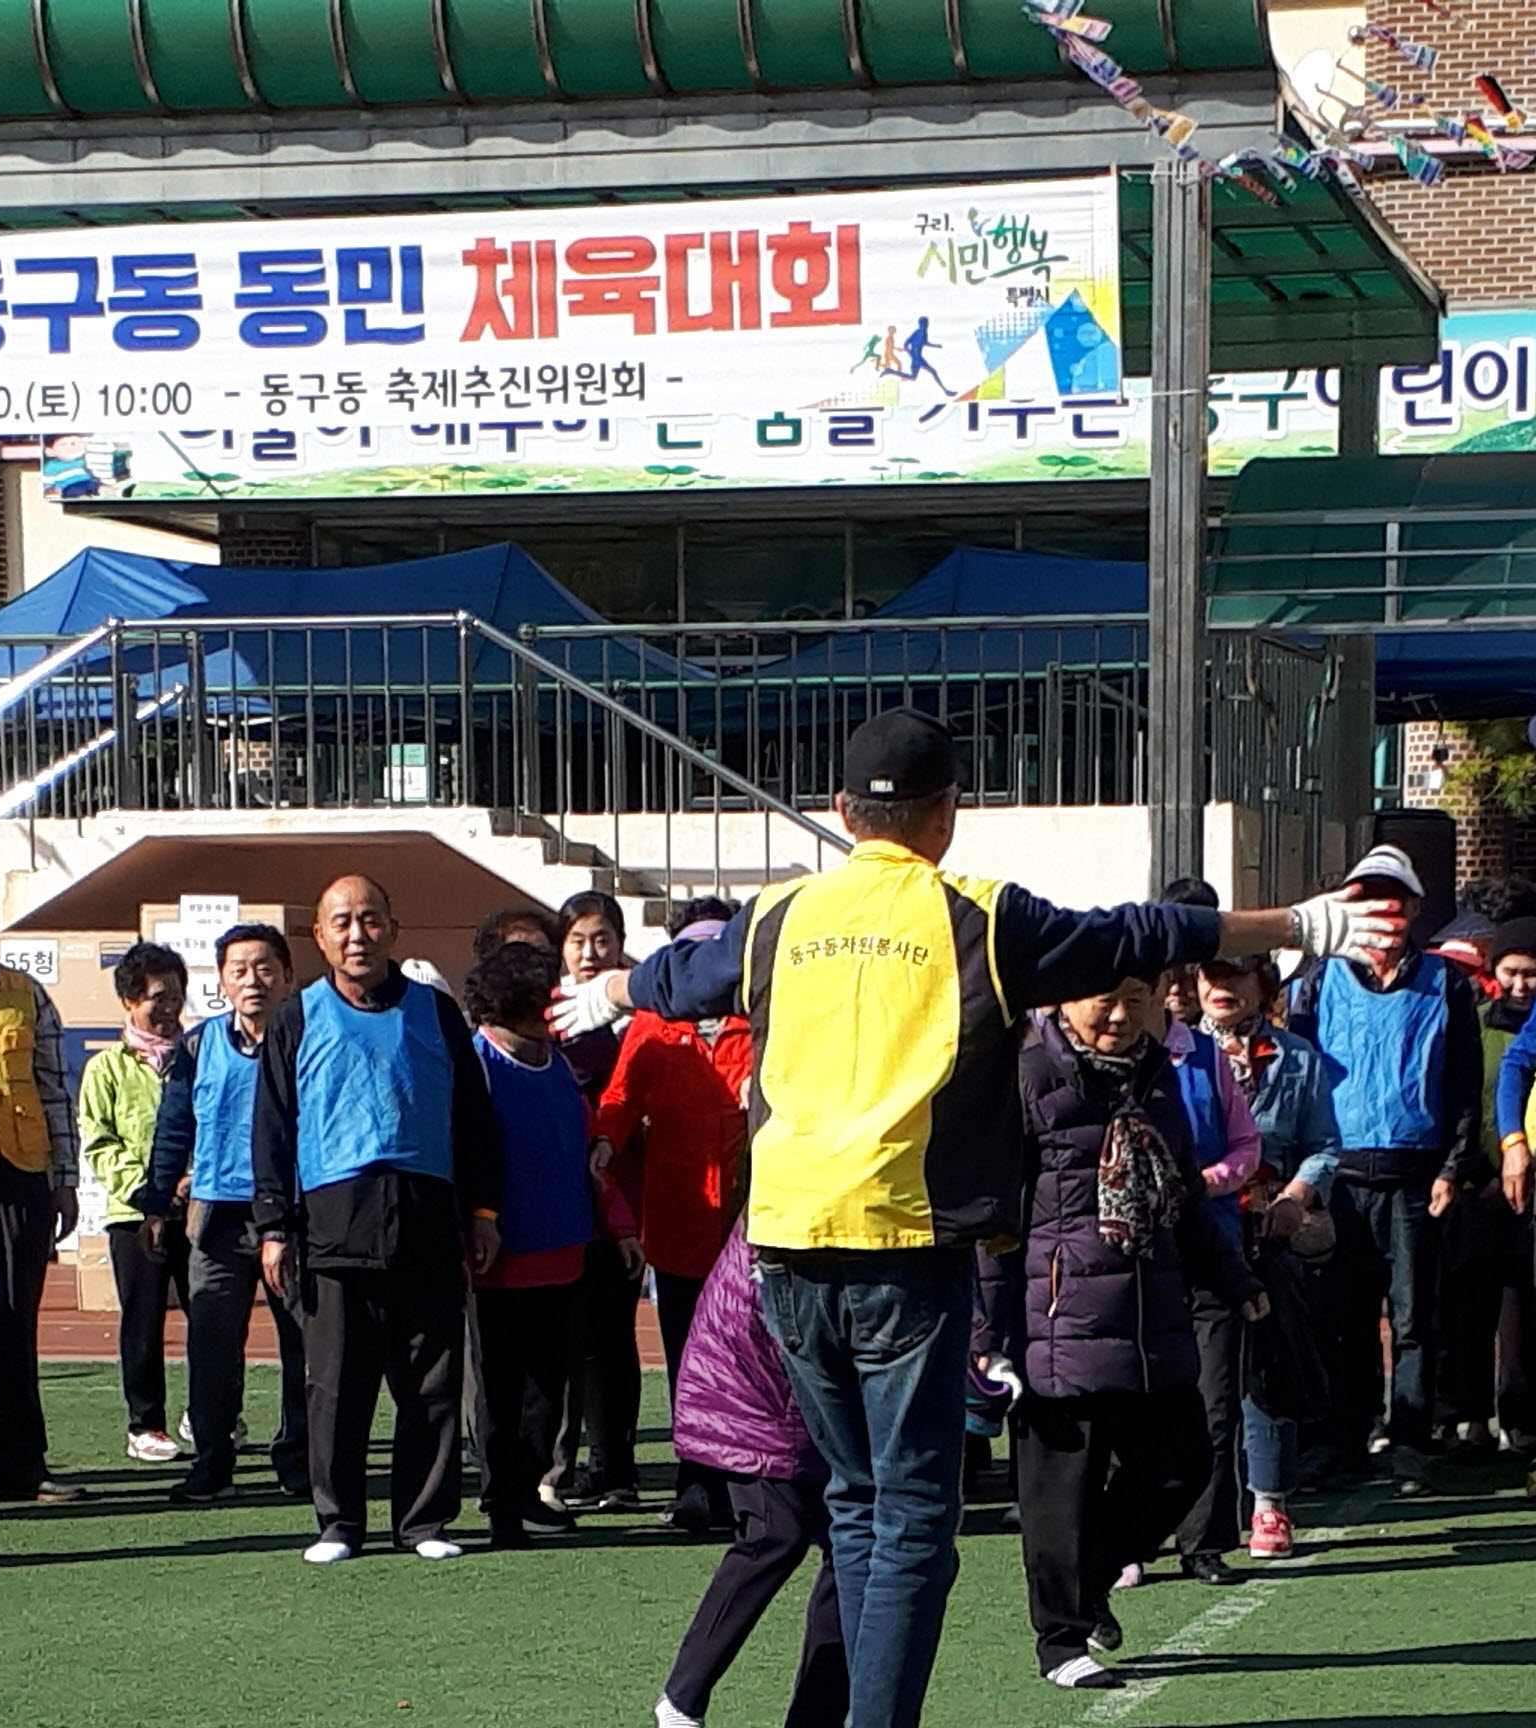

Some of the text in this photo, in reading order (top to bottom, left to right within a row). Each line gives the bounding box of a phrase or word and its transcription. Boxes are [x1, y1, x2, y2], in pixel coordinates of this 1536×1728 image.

[234, 244, 426, 349] 동민
[459, 220, 862, 343] 체육대회
[98, 380, 192, 418] 10:00
[259, 372, 368, 417] 동구동
[385, 360, 648, 412] 축제추진위원회
[4, 951, 54, 975] 55형
